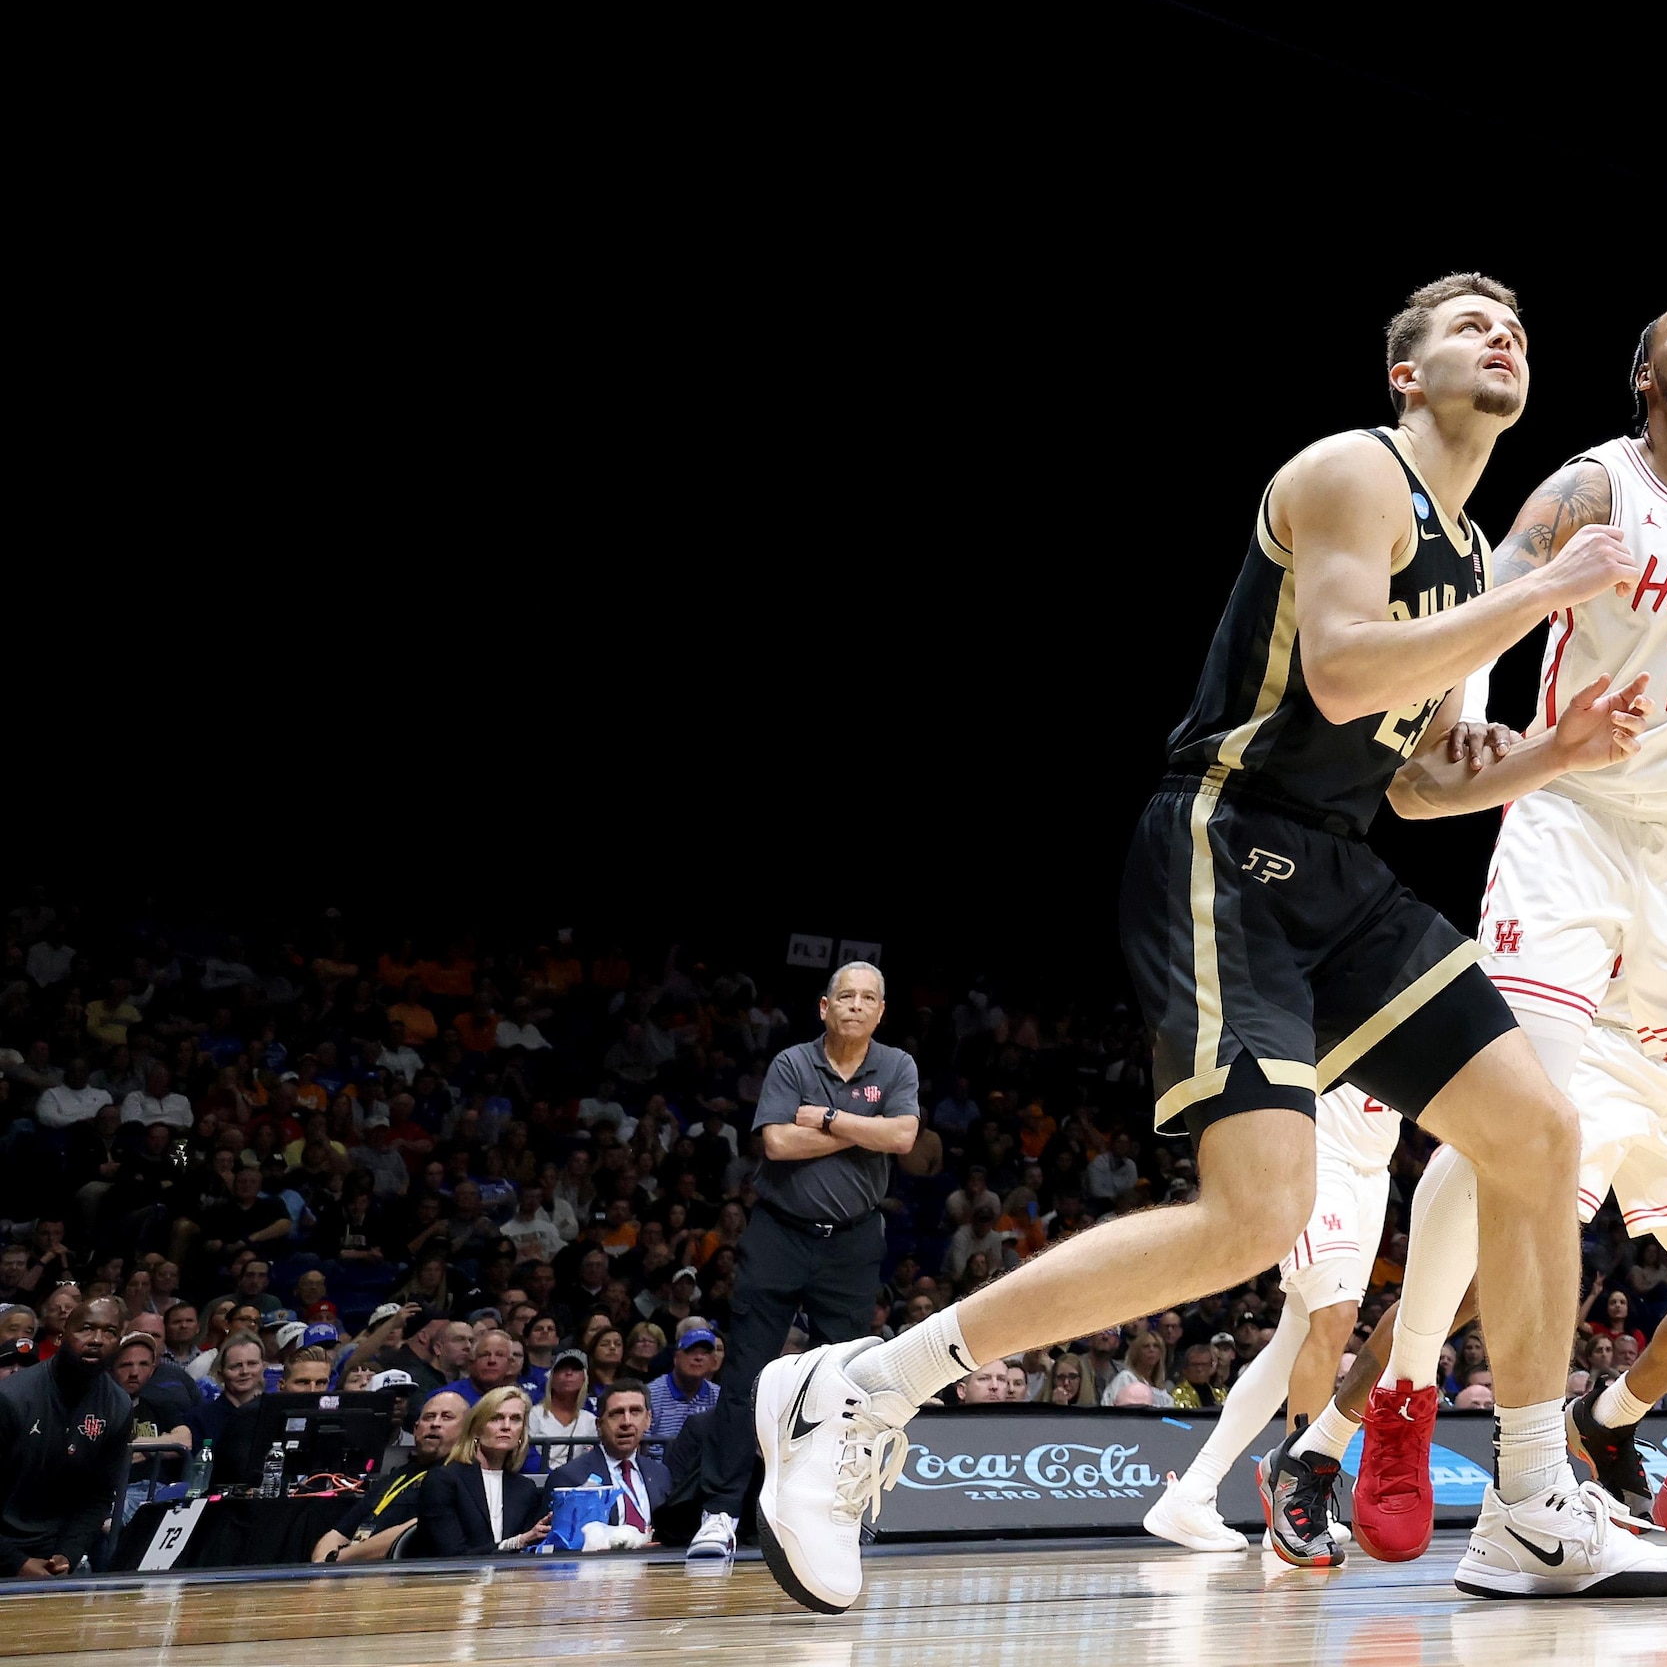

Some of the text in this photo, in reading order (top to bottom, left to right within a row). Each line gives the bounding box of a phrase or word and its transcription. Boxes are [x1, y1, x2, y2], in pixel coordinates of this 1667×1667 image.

[885, 1443, 1161, 1489] Coca-Cola
[964, 1488, 1144, 1500] ZERO SUGAR
[158, 1527, 183, 1550] T2
